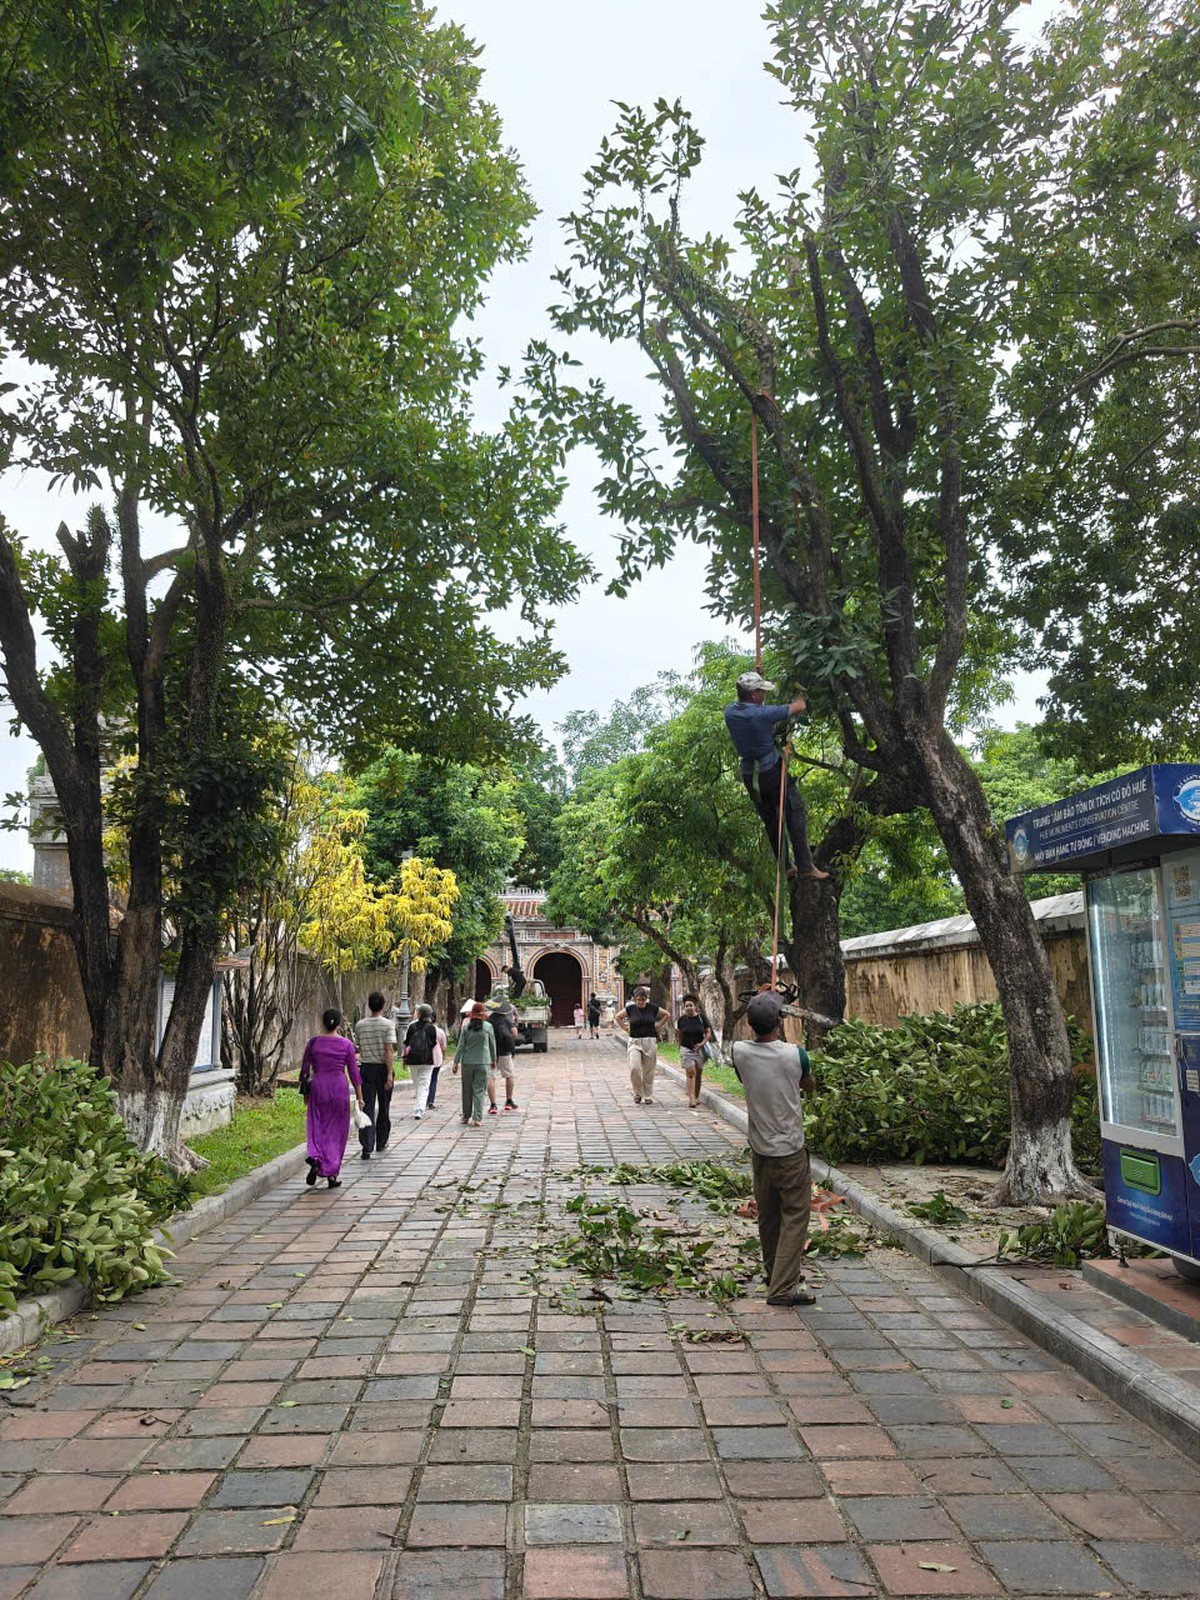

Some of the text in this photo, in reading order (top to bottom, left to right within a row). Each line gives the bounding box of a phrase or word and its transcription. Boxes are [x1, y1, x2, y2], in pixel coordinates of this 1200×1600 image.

[1032, 815, 1051, 829] TRUNG
[1096, 793, 1110, 808] TÍCH
[1079, 807, 1117, 828] CONSERVATION
[1117, 799, 1140, 816] CENTRE
[1096, 828, 1122, 845] VENDING
[1122, 819, 1150, 838] MACHINE
